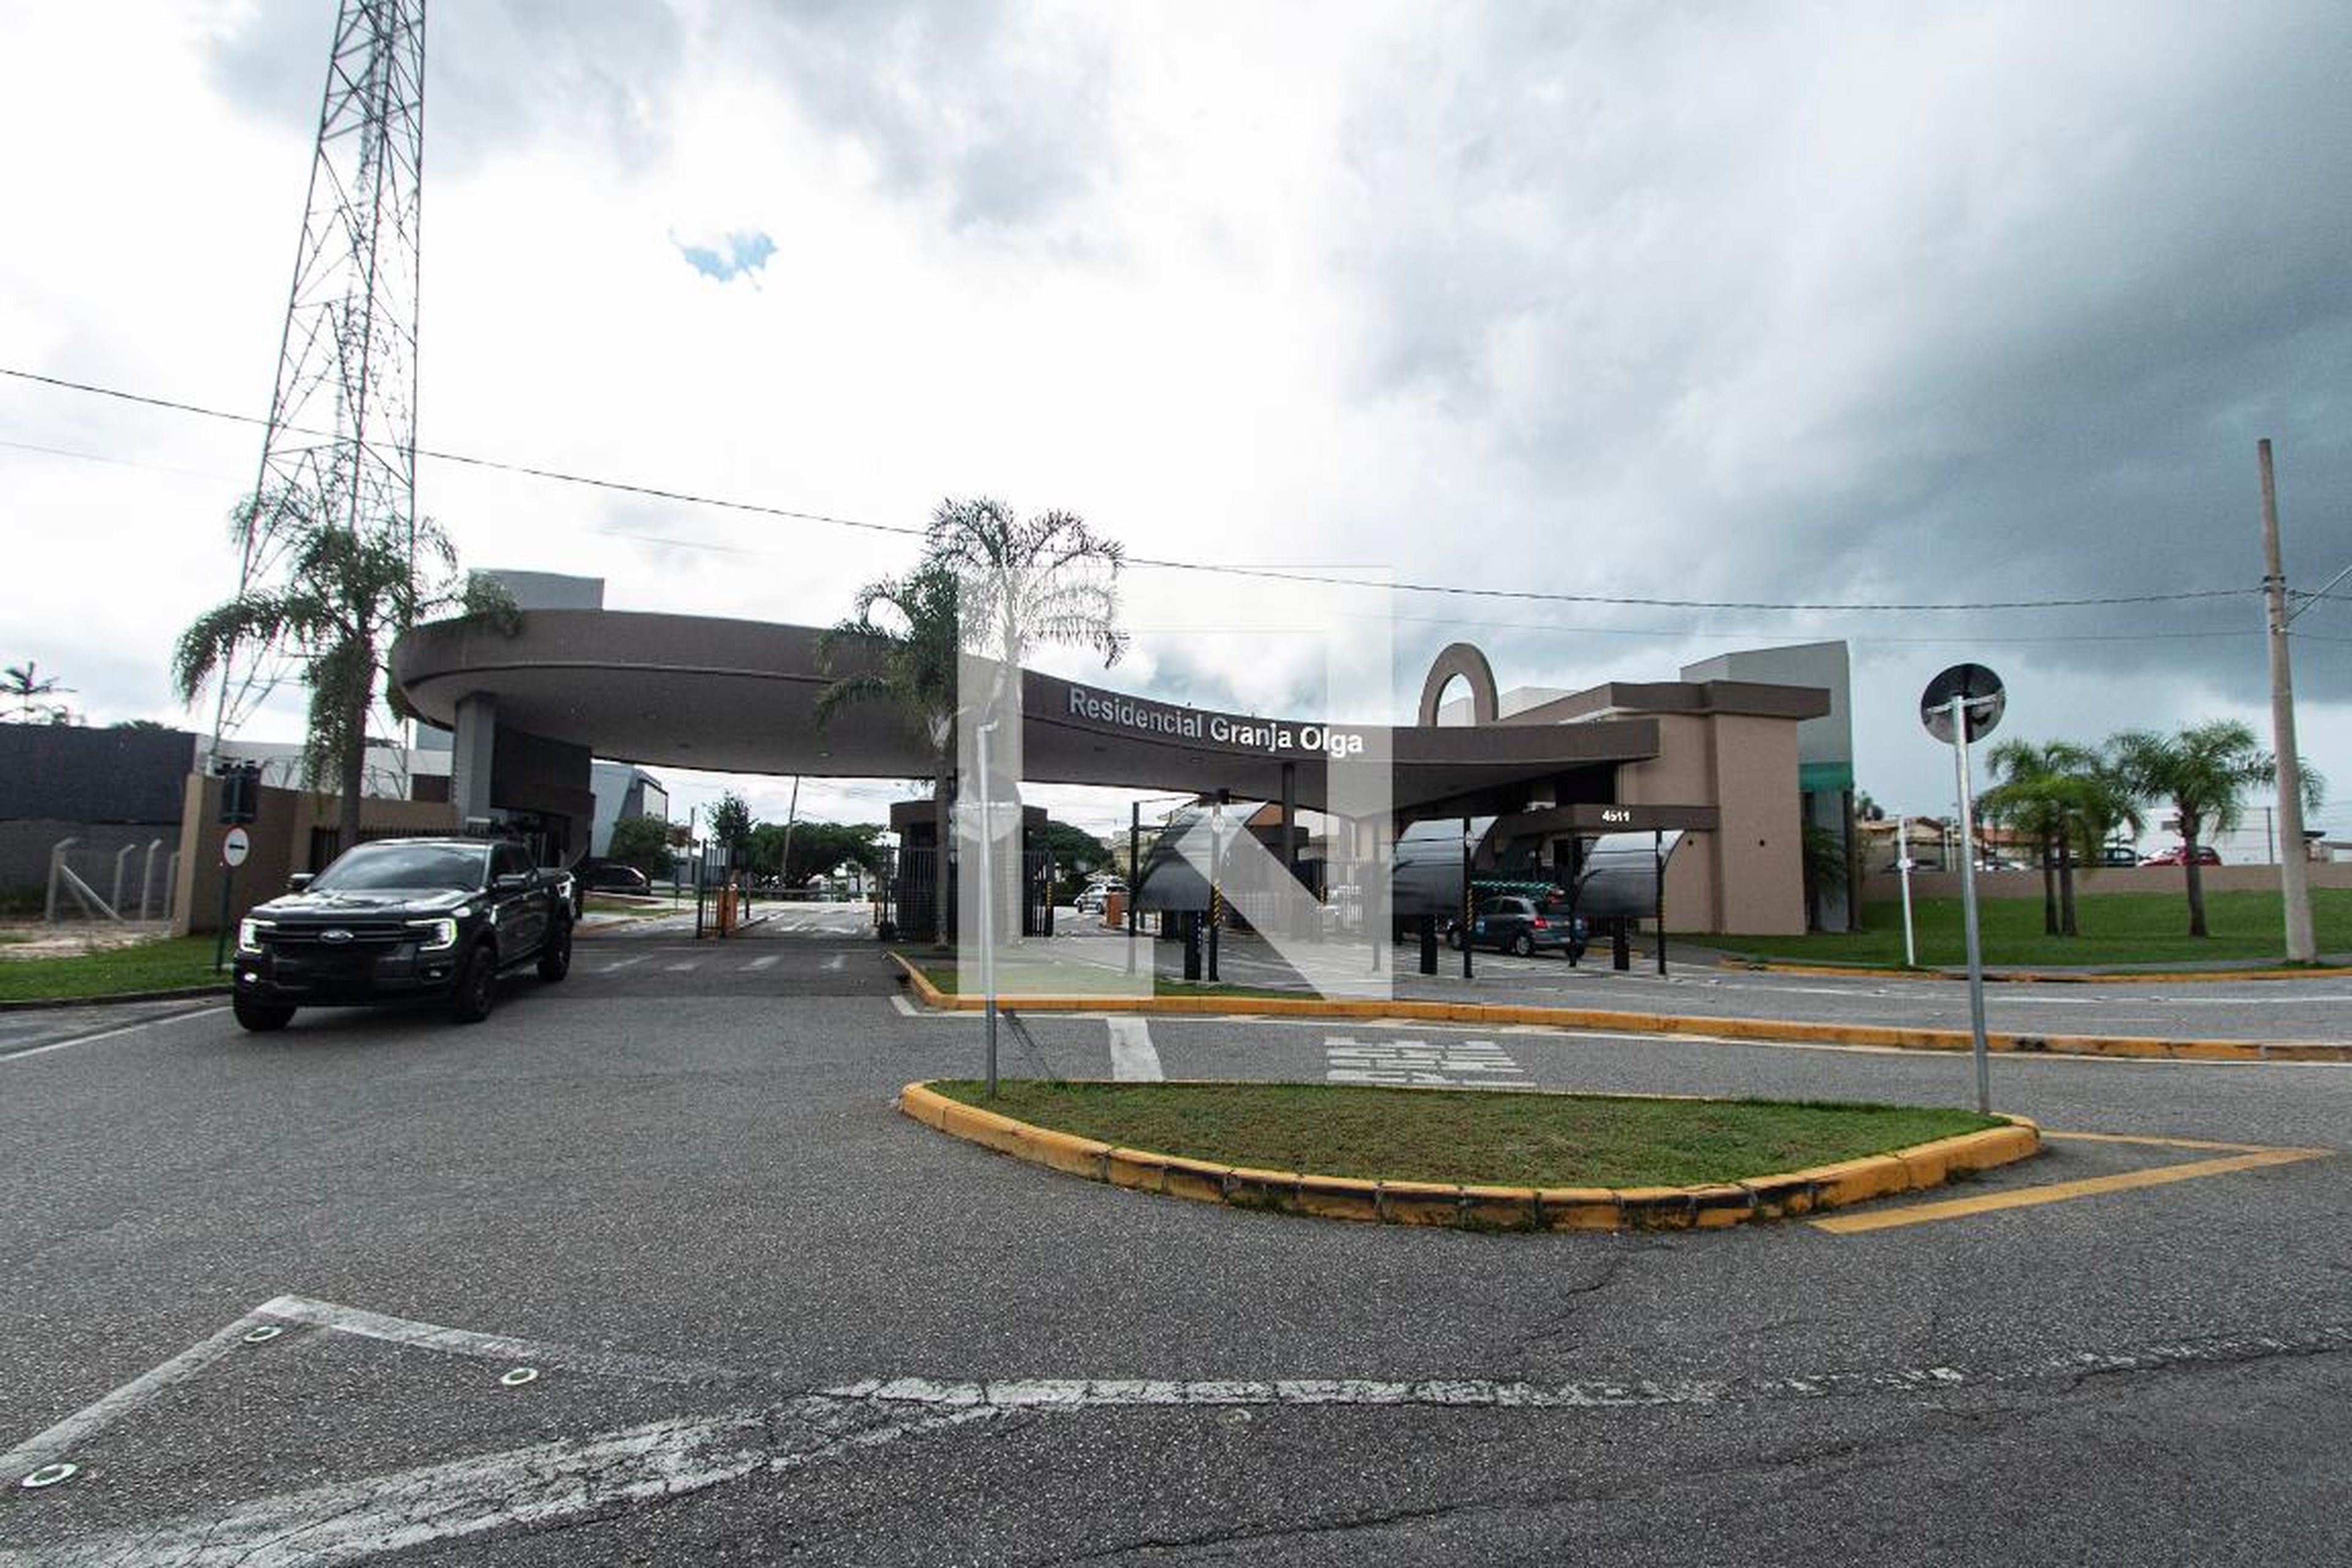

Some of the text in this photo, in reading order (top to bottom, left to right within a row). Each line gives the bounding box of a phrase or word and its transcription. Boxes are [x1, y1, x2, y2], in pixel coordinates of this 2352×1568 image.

[1069, 687, 1363, 758] Residencial Granja Olga
[1602, 810, 1630, 821] 4511
